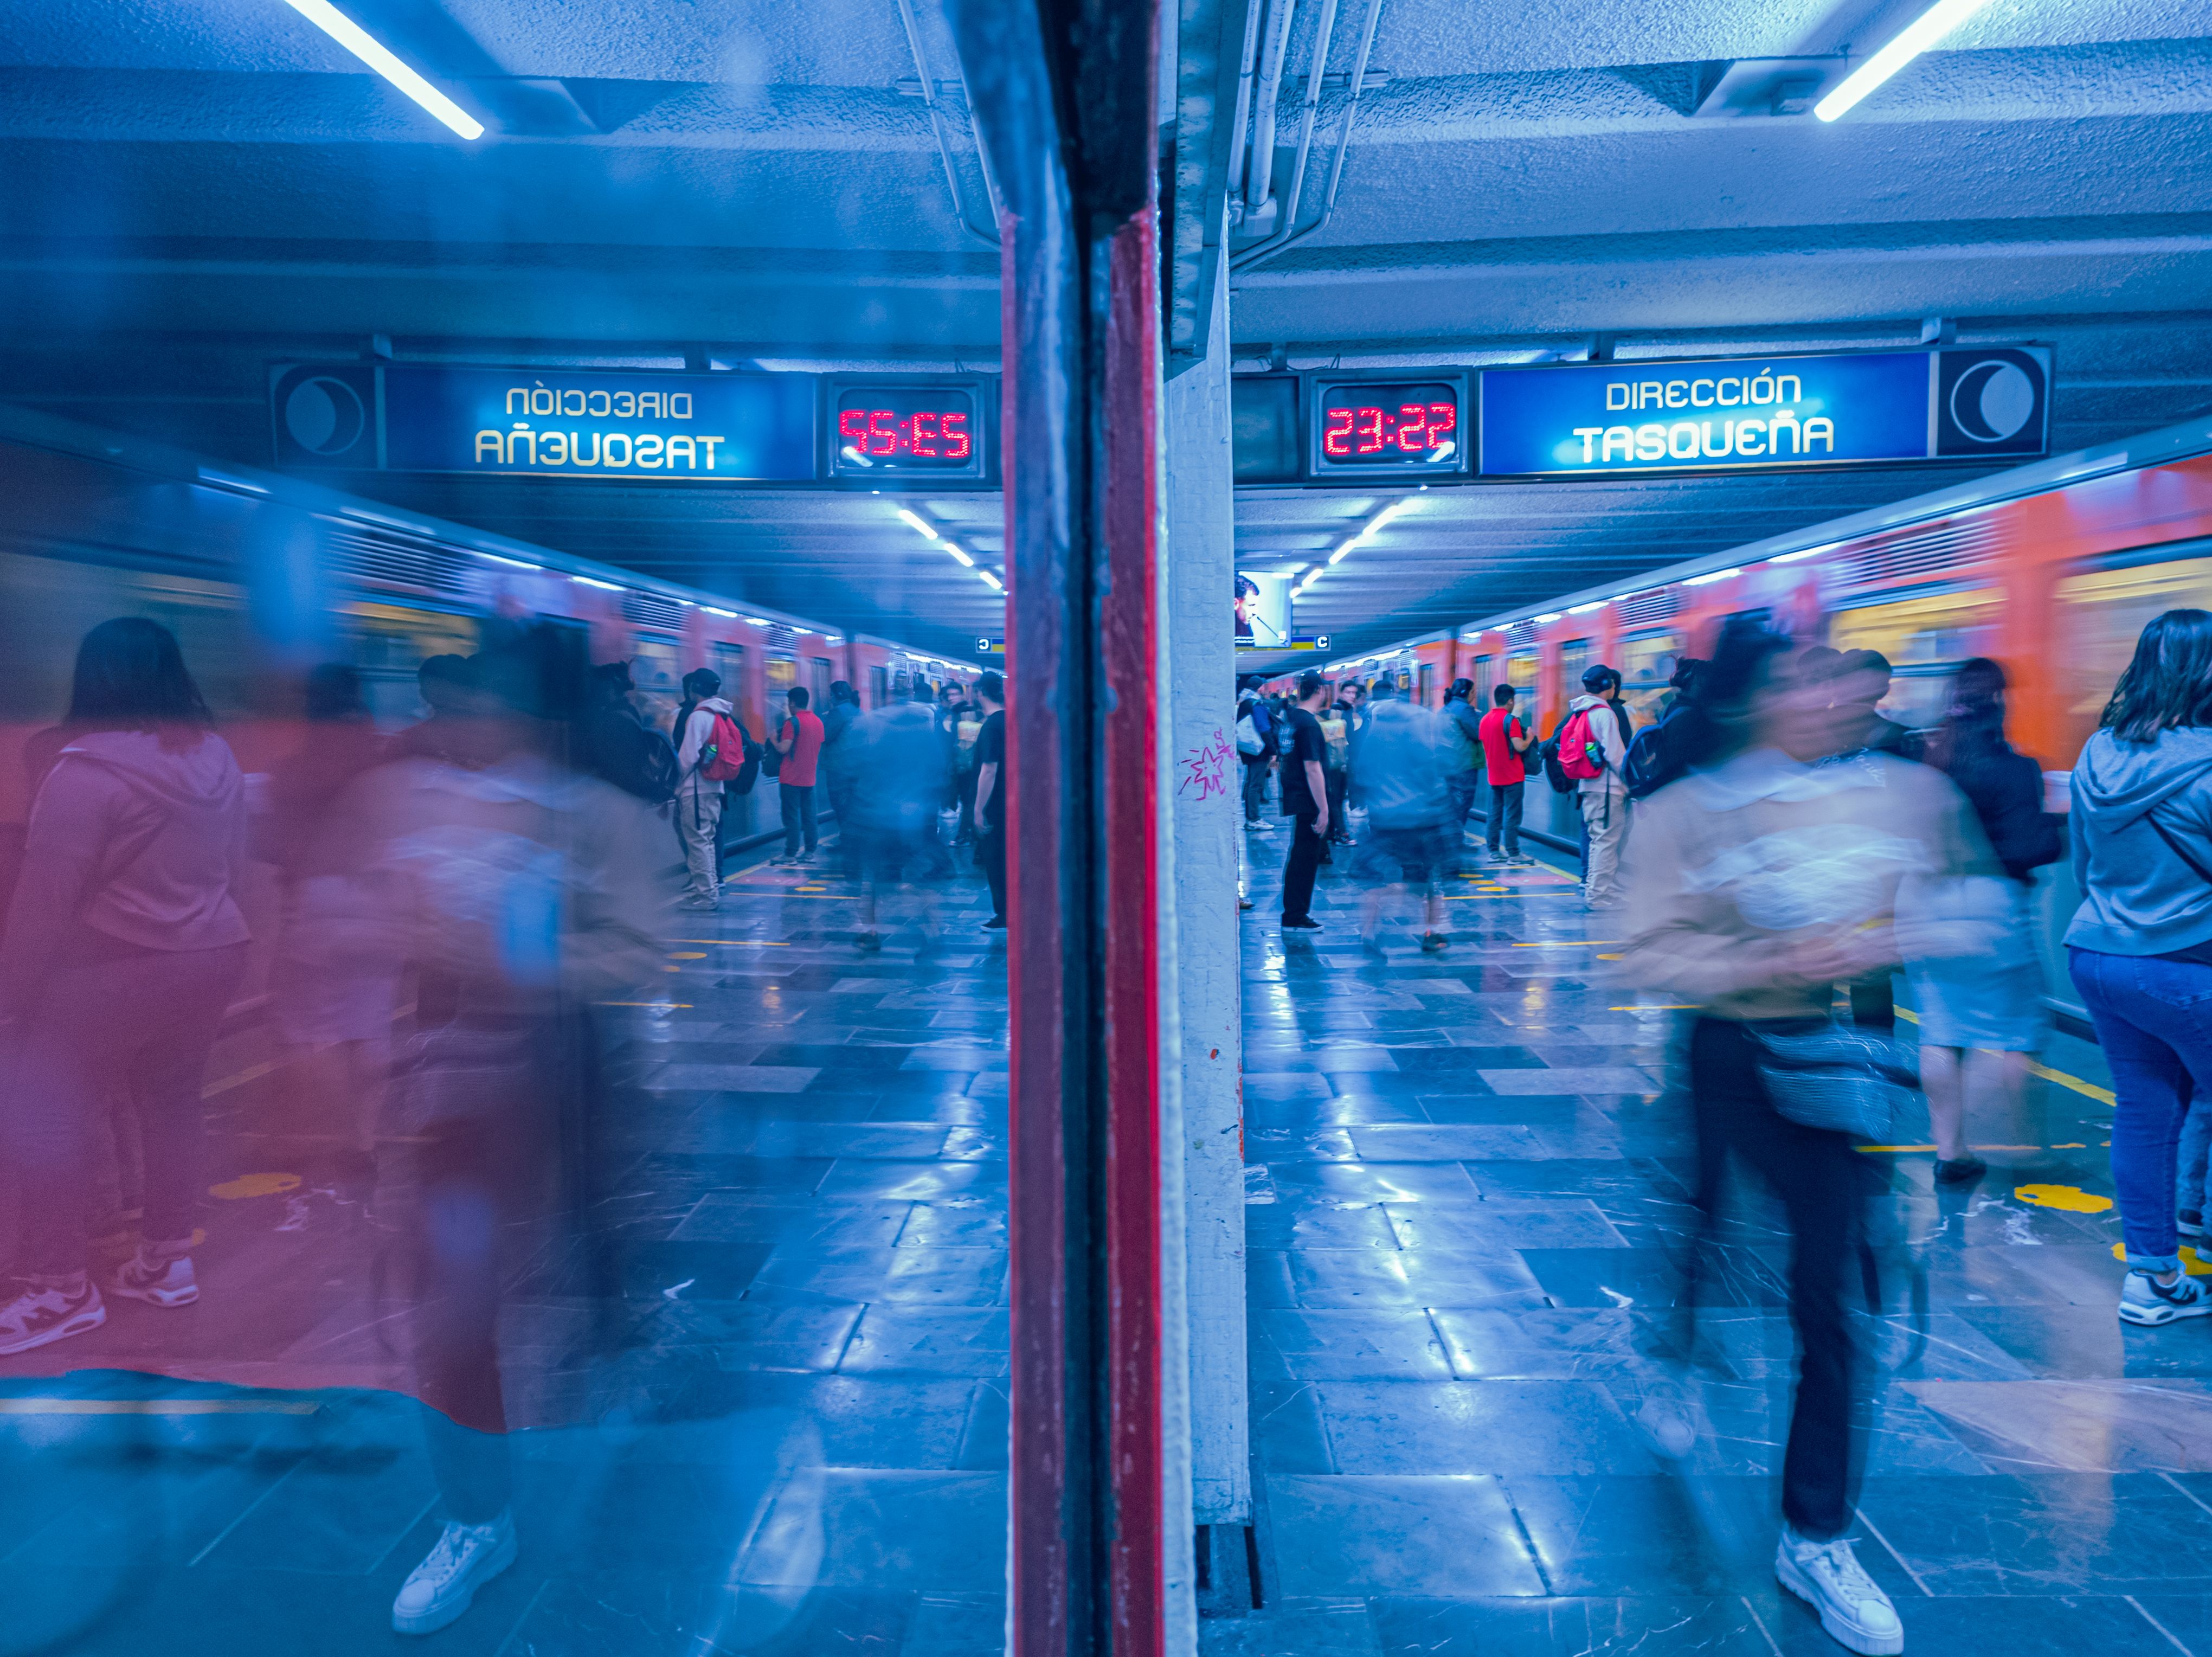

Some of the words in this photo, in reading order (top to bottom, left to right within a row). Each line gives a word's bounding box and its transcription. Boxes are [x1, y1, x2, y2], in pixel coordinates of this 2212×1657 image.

[1606, 367, 1802, 410] DIRECCIÓN
[1324, 402, 1456, 455] 23:22
[1573, 408, 1834, 464] TASQUEÑA
[1317, 637, 1328, 647] C
